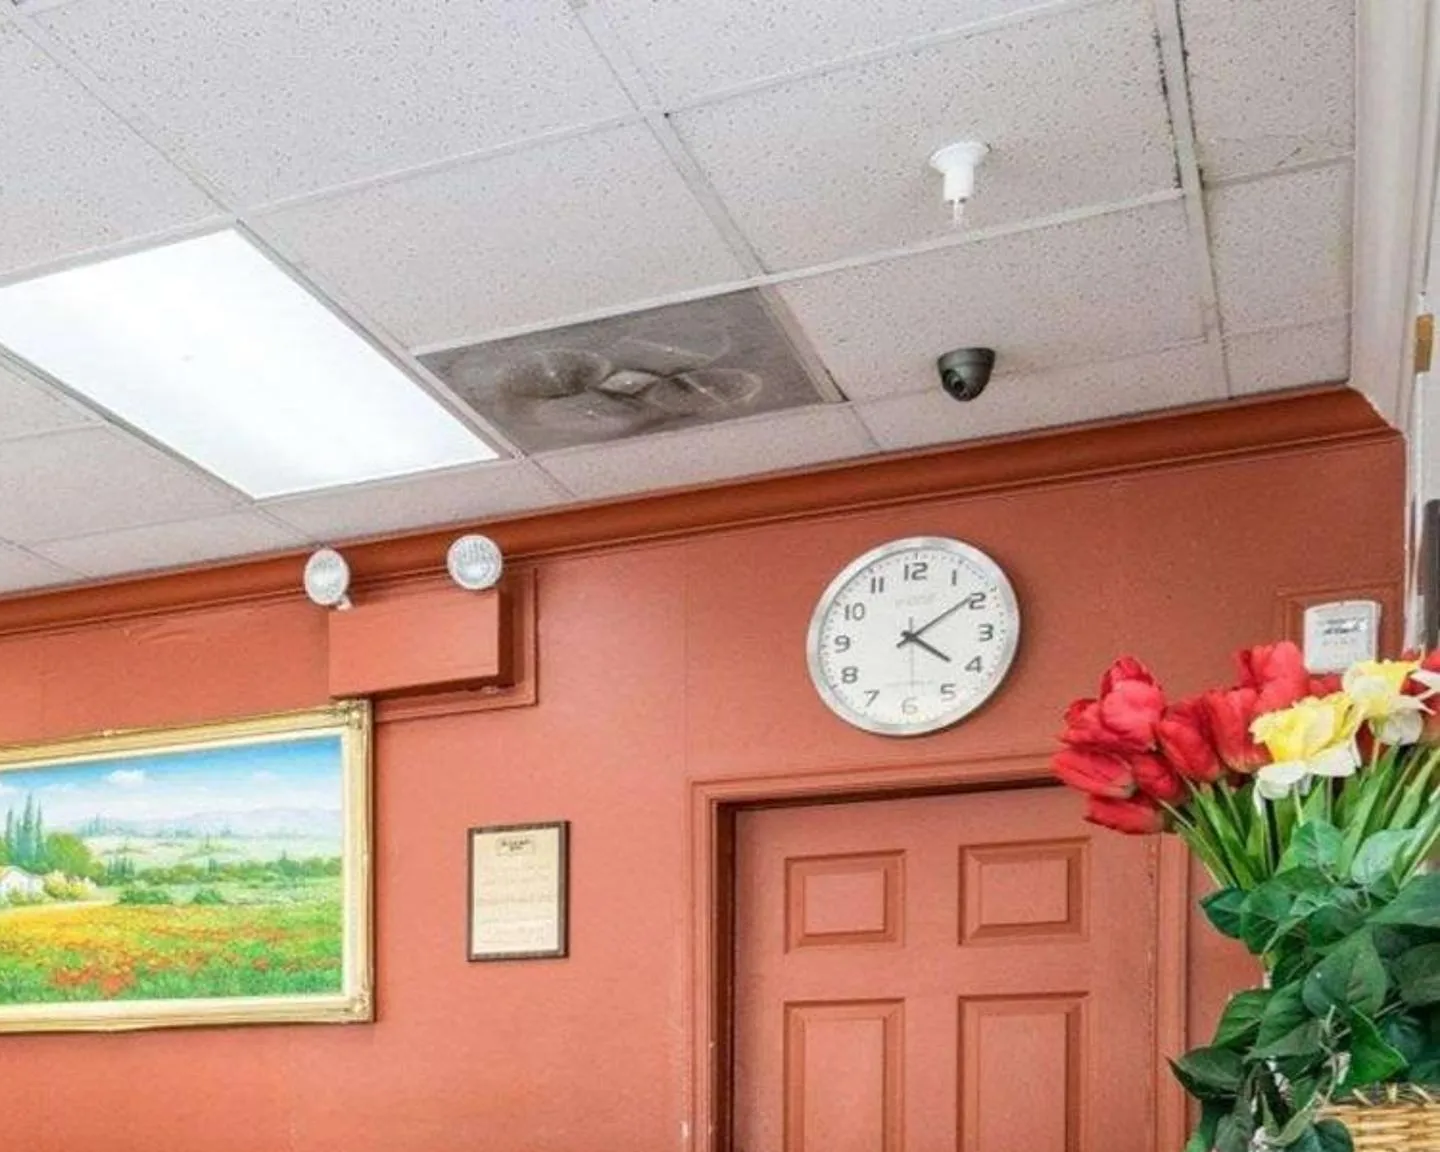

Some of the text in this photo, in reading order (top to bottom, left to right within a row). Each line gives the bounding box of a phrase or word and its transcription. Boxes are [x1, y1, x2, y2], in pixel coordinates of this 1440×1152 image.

[903, 562, 928, 581] 12
[951, 569, 957, 586] 1
[870, 577, 885, 593] 11
[968, 592, 987, 610] 2
[845, 602, 866, 620] 10
[978, 623, 994, 641] 3
[835, 634, 851, 653] 9
[965, 655, 983, 673] 4
[841, 666, 859, 684] 8
[864, 689, 880, 707] 7
[940, 683, 956, 700] 5
[901, 697, 918, 716] 6
